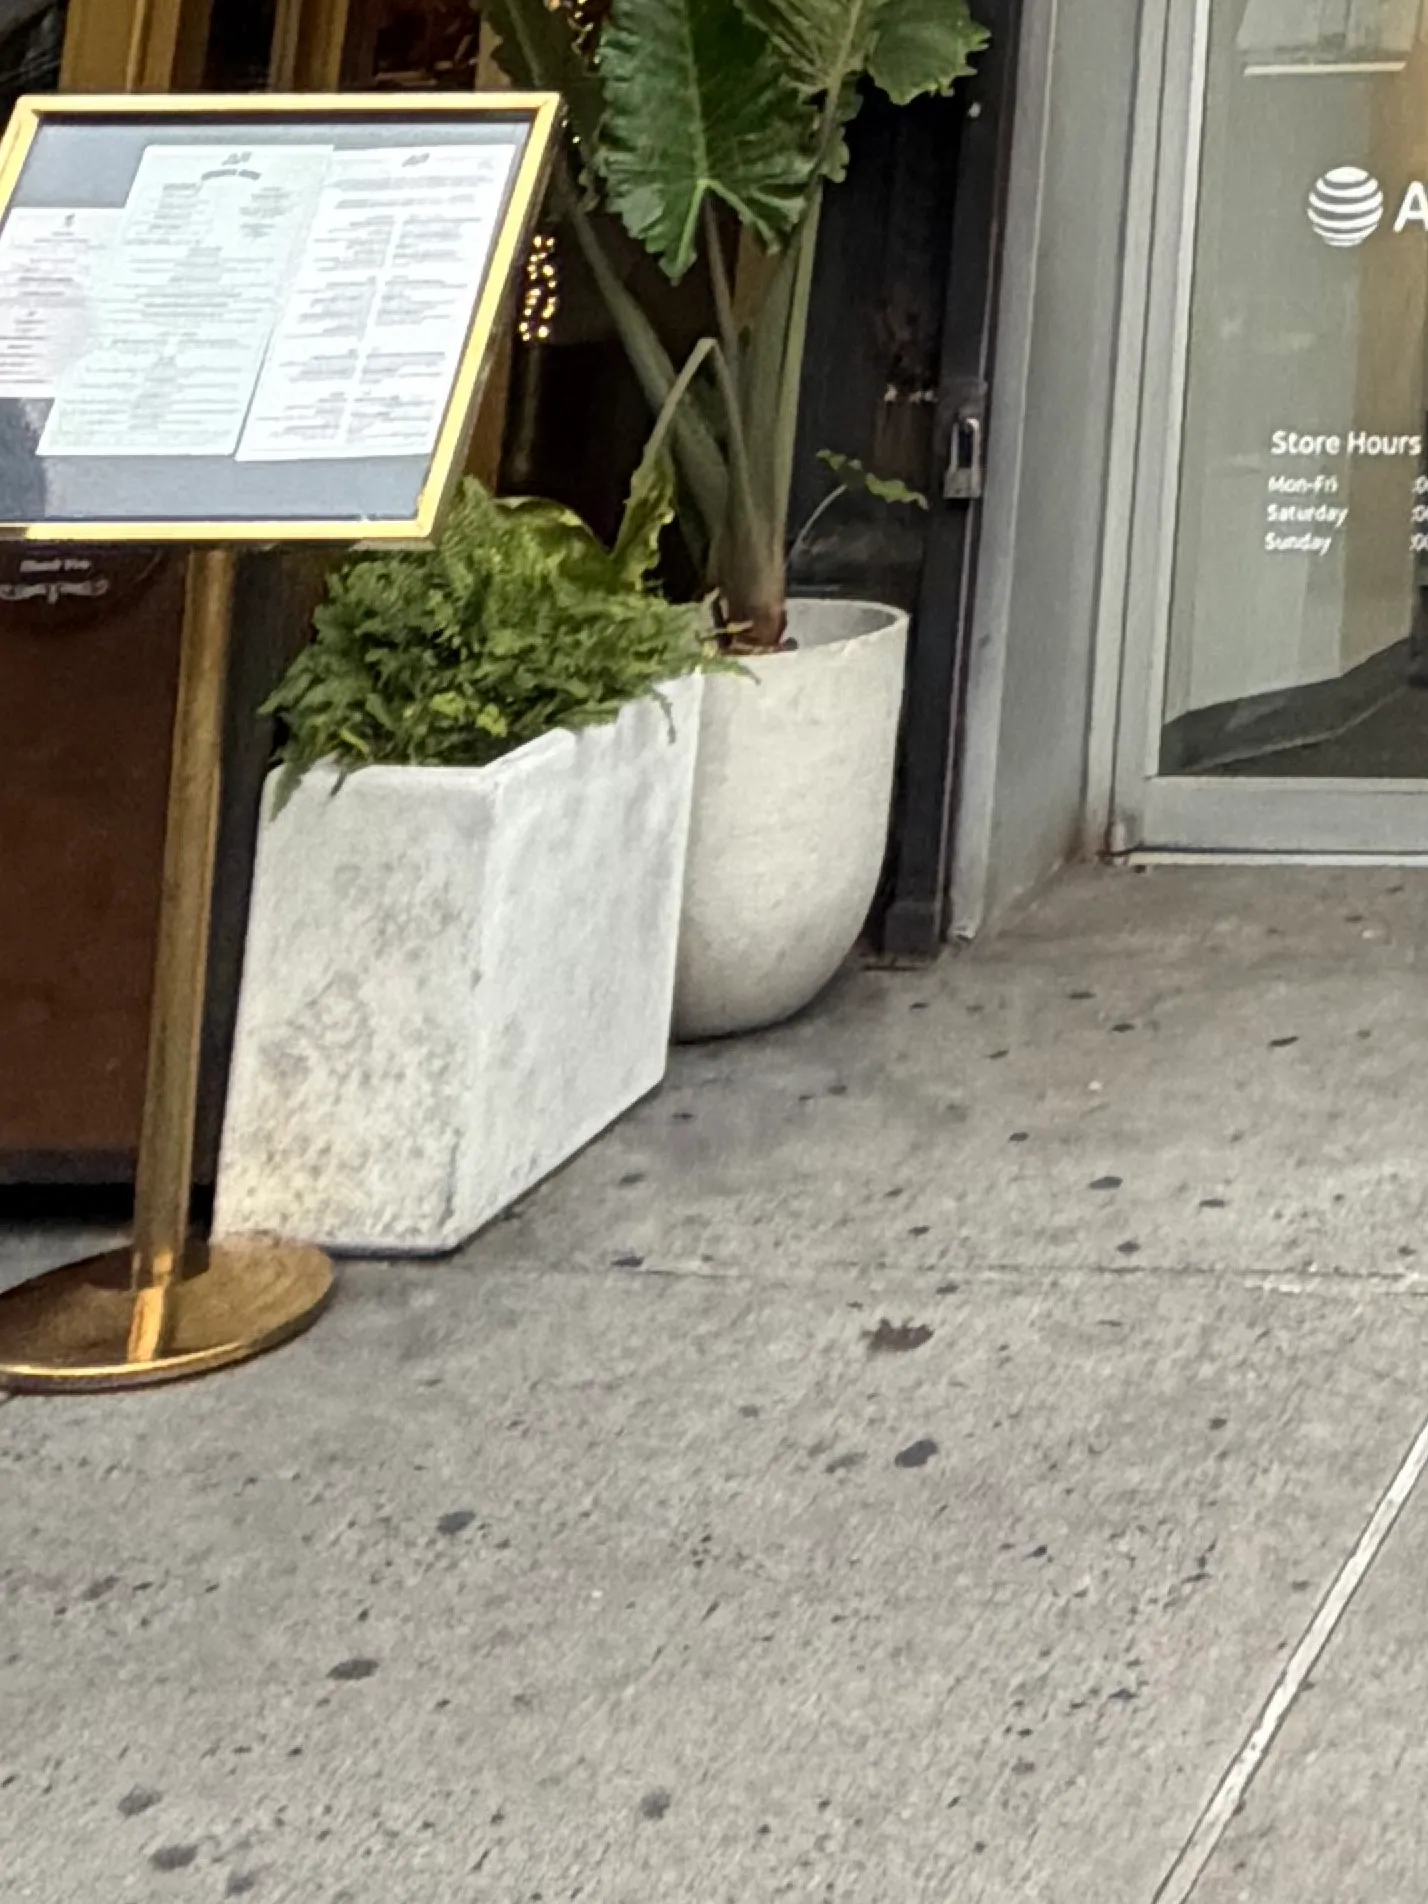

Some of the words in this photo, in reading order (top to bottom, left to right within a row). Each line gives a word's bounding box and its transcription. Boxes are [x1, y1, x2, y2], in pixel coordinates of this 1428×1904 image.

[1270, 430, 1340, 456] Store
[1348, 431, 1422, 456] Hours
[1268, 475, 1338, 495] Mon-Fri
[1266, 503, 1349, 528] Saturday
[1264, 532, 1332, 556] Sunday
